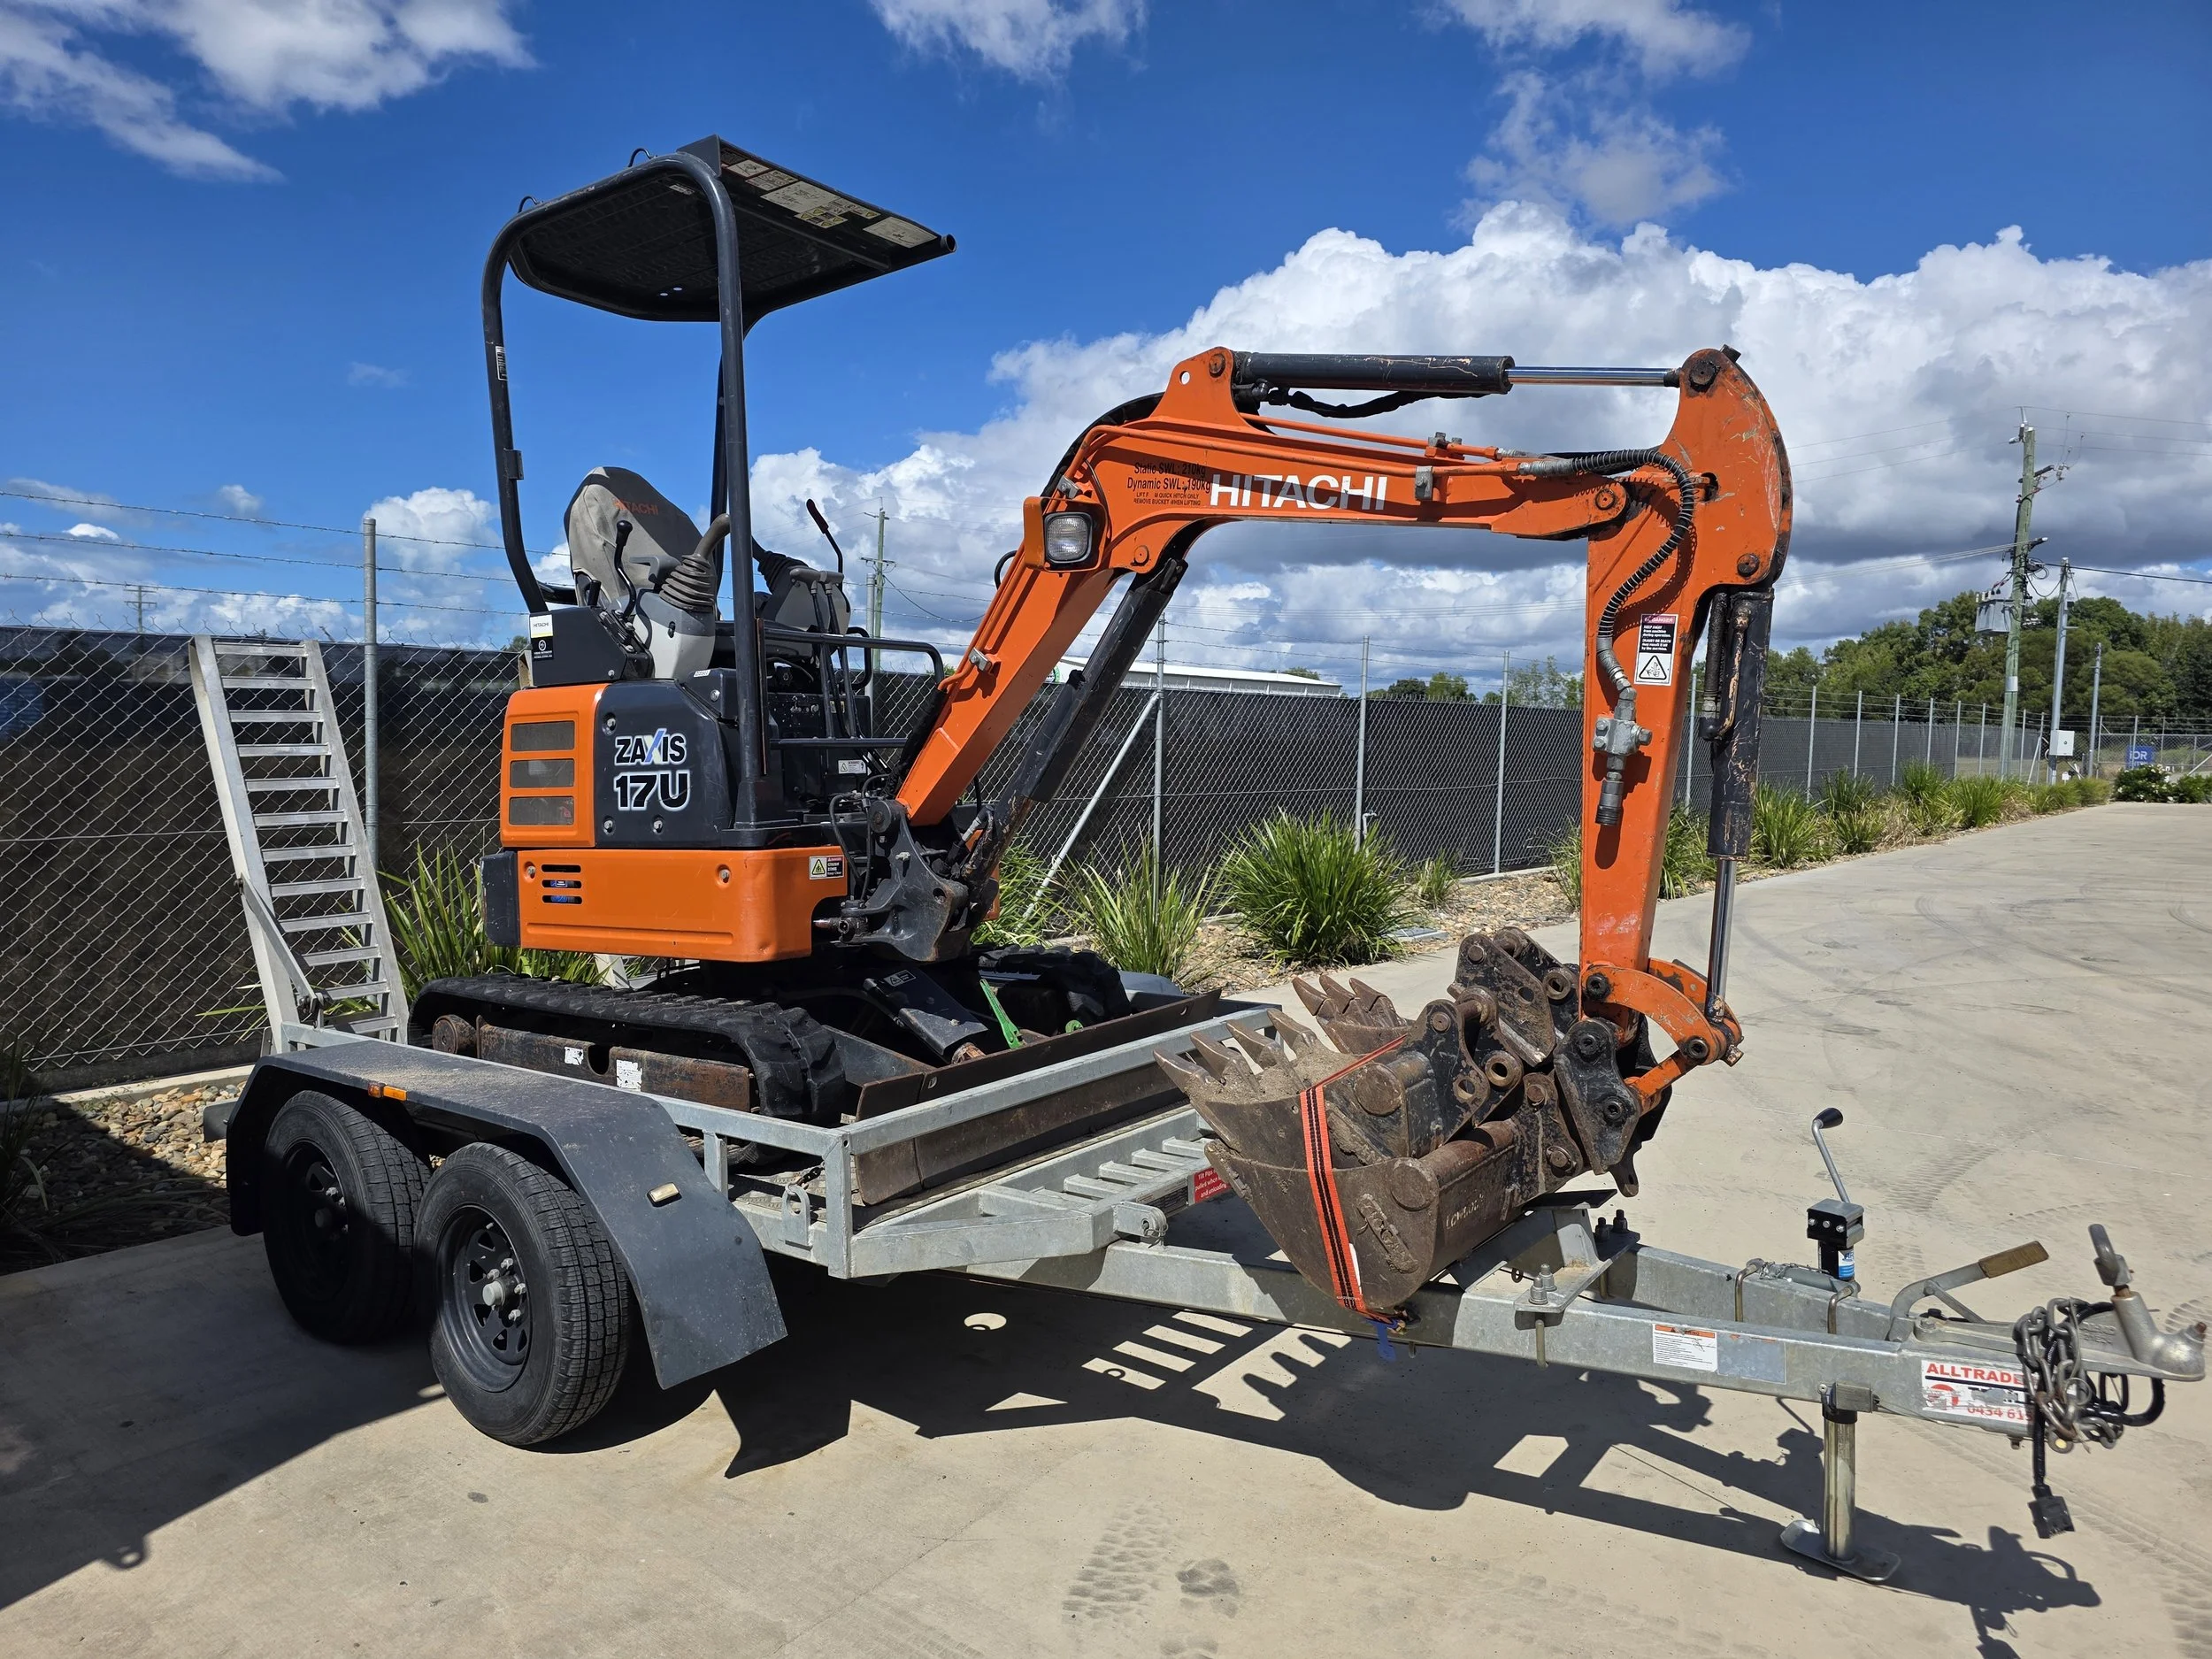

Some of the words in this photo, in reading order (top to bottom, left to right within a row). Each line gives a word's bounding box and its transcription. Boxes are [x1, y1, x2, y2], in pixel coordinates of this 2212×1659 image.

[1127, 477, 1161, 491] Dynamic
[1187, 479, 1210, 494] 190kg
[1134, 462, 1156, 474] Static
[1159, 462, 1179, 475] SWL:
[1182, 463, 1206, 478] 210kg
[1210, 474, 1387, 511] HITACHI
[614, 728, 687, 766] ZAXIS
[613, 770, 690, 811] 17U
